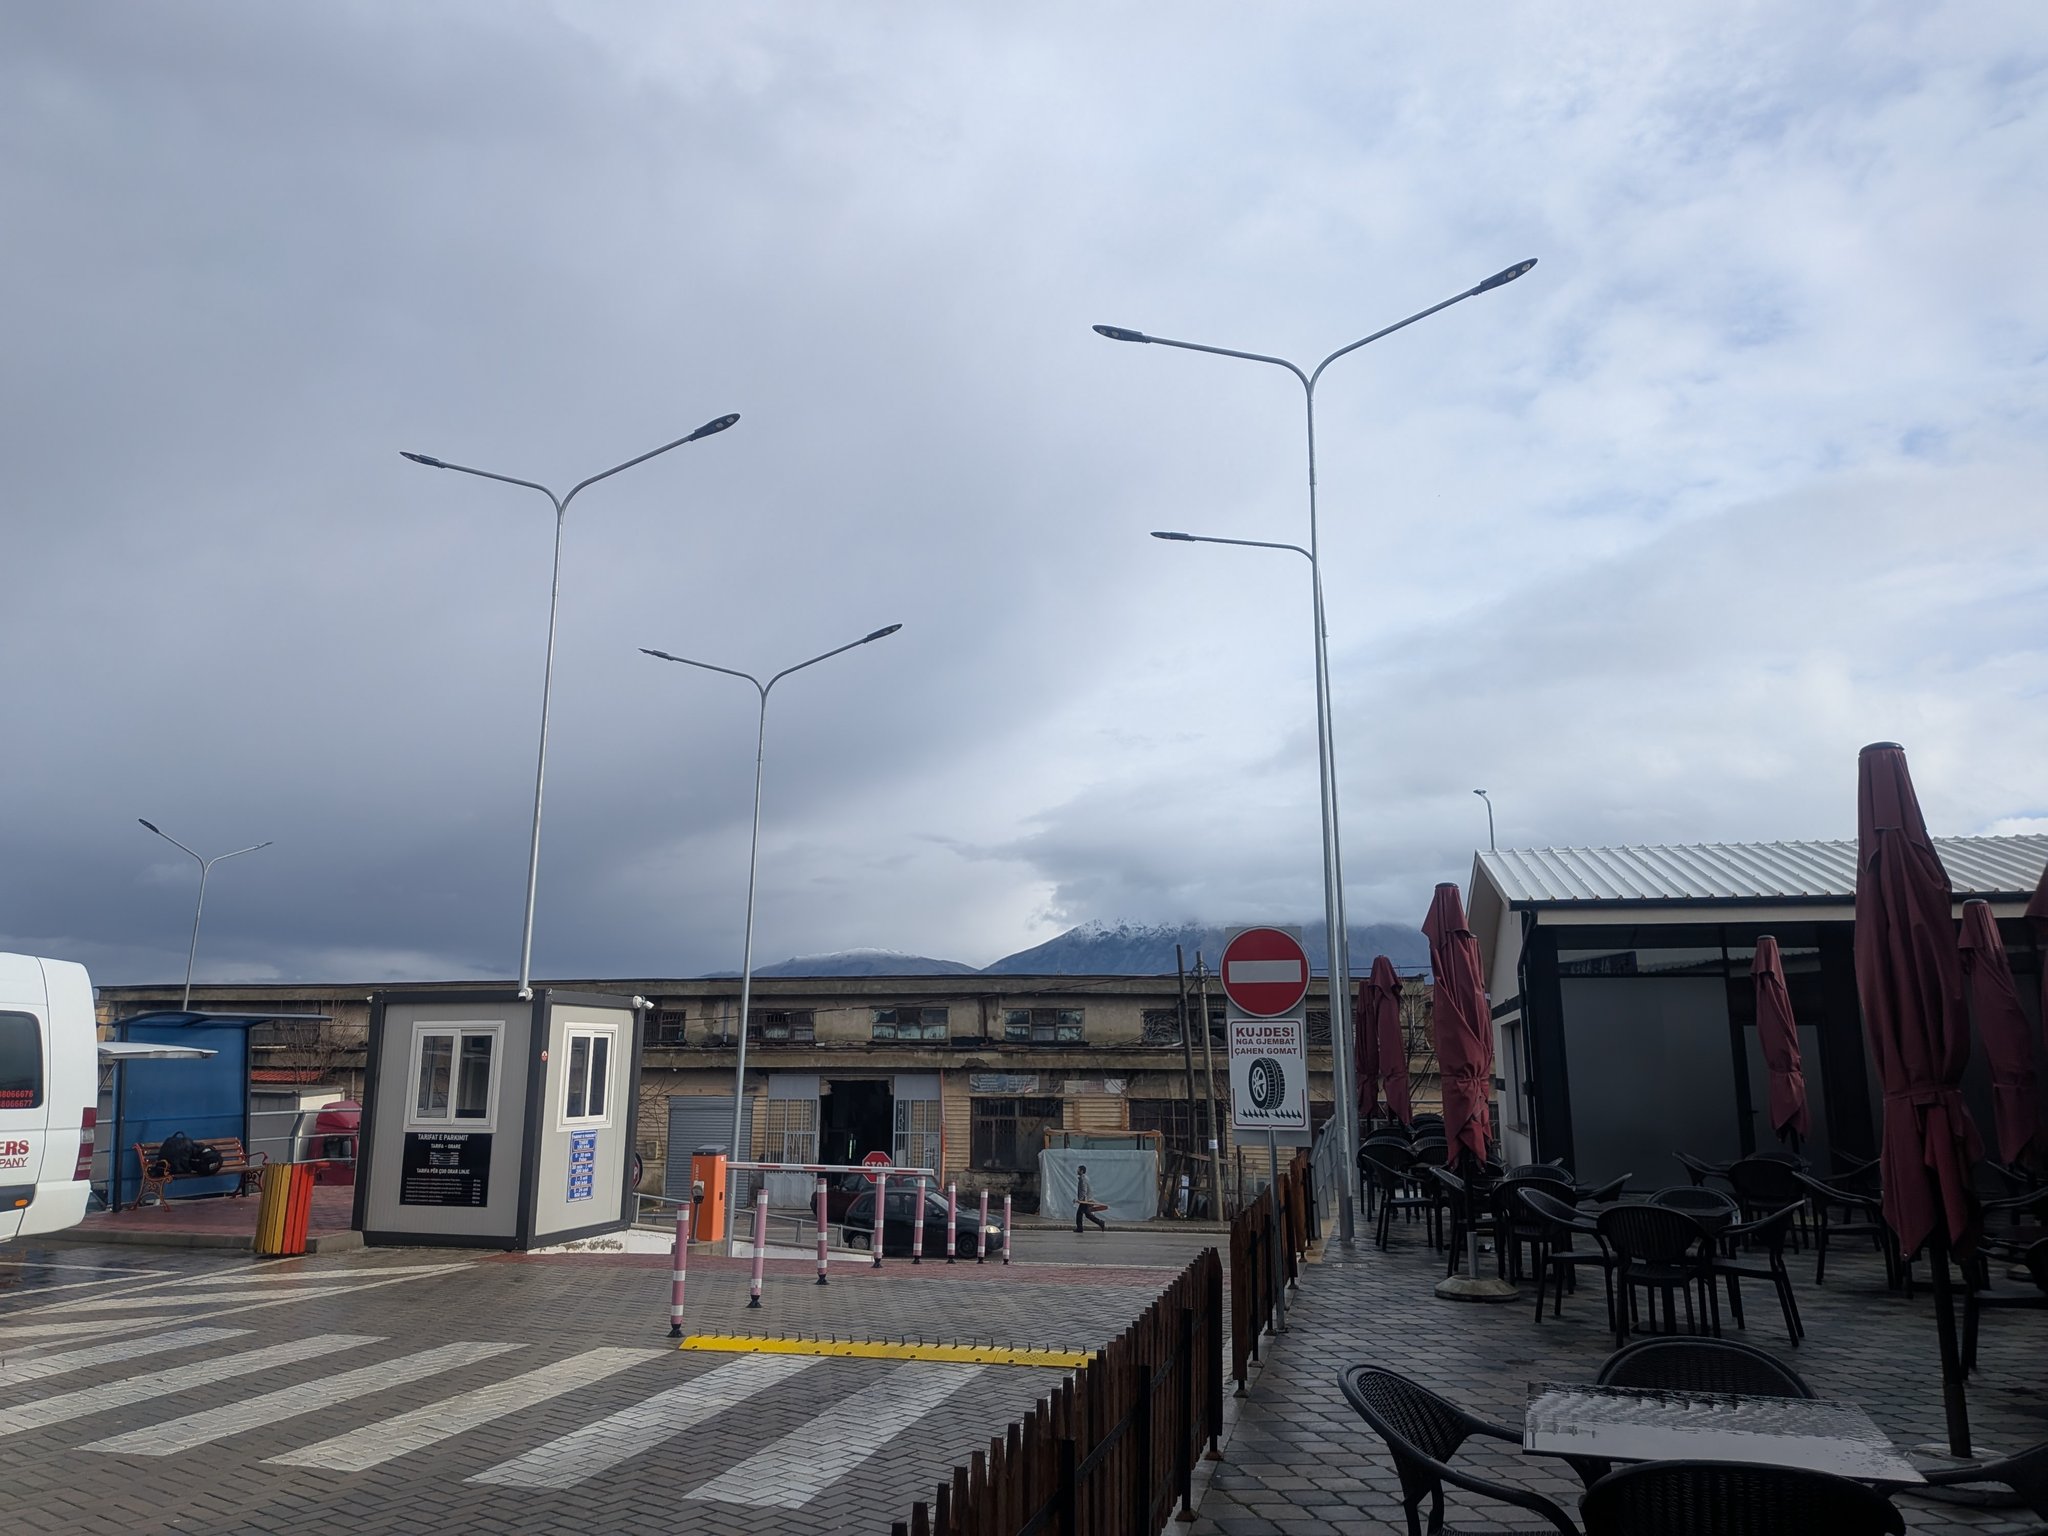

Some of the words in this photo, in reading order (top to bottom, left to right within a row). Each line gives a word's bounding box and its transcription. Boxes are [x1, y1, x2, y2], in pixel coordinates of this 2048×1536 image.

[1235, 1027, 1295, 1037] KUJDES!
[1234, 1047, 1264, 1056] ÇAHEN
[1266, 1047, 1298, 1055] GOMAT
